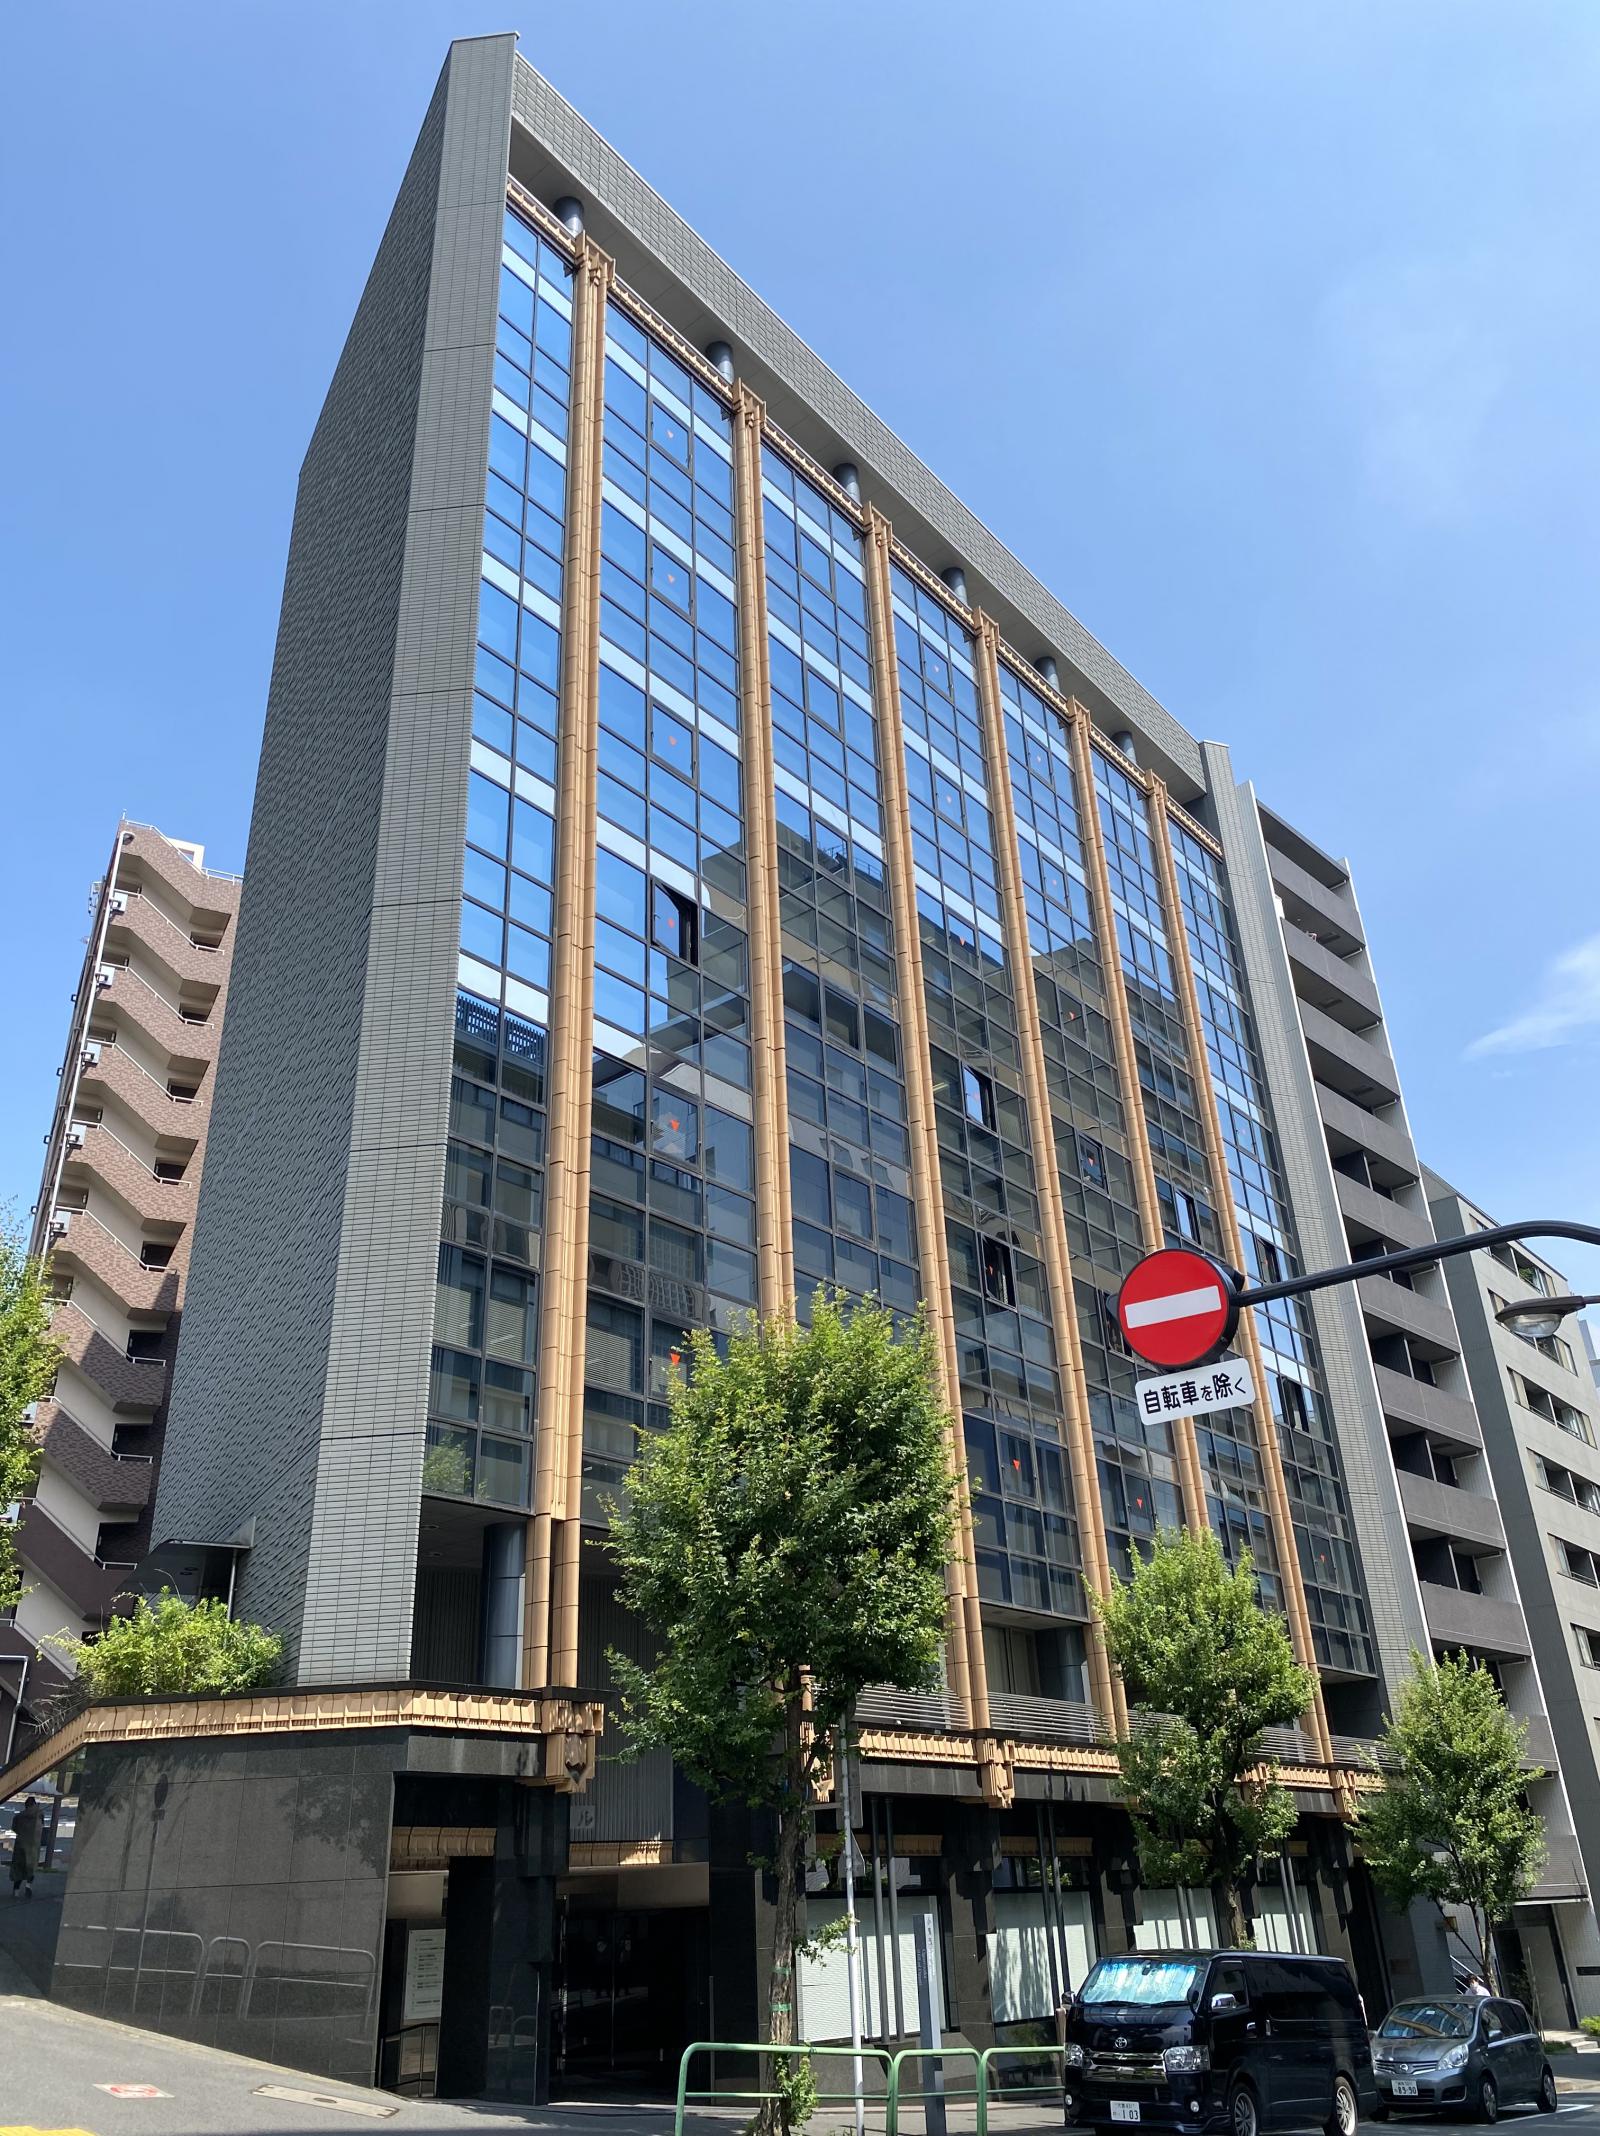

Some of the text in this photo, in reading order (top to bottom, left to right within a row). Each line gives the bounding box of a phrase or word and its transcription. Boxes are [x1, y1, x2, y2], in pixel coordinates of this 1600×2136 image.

[1143, 1372, 1247, 1415] 自転車を除く
